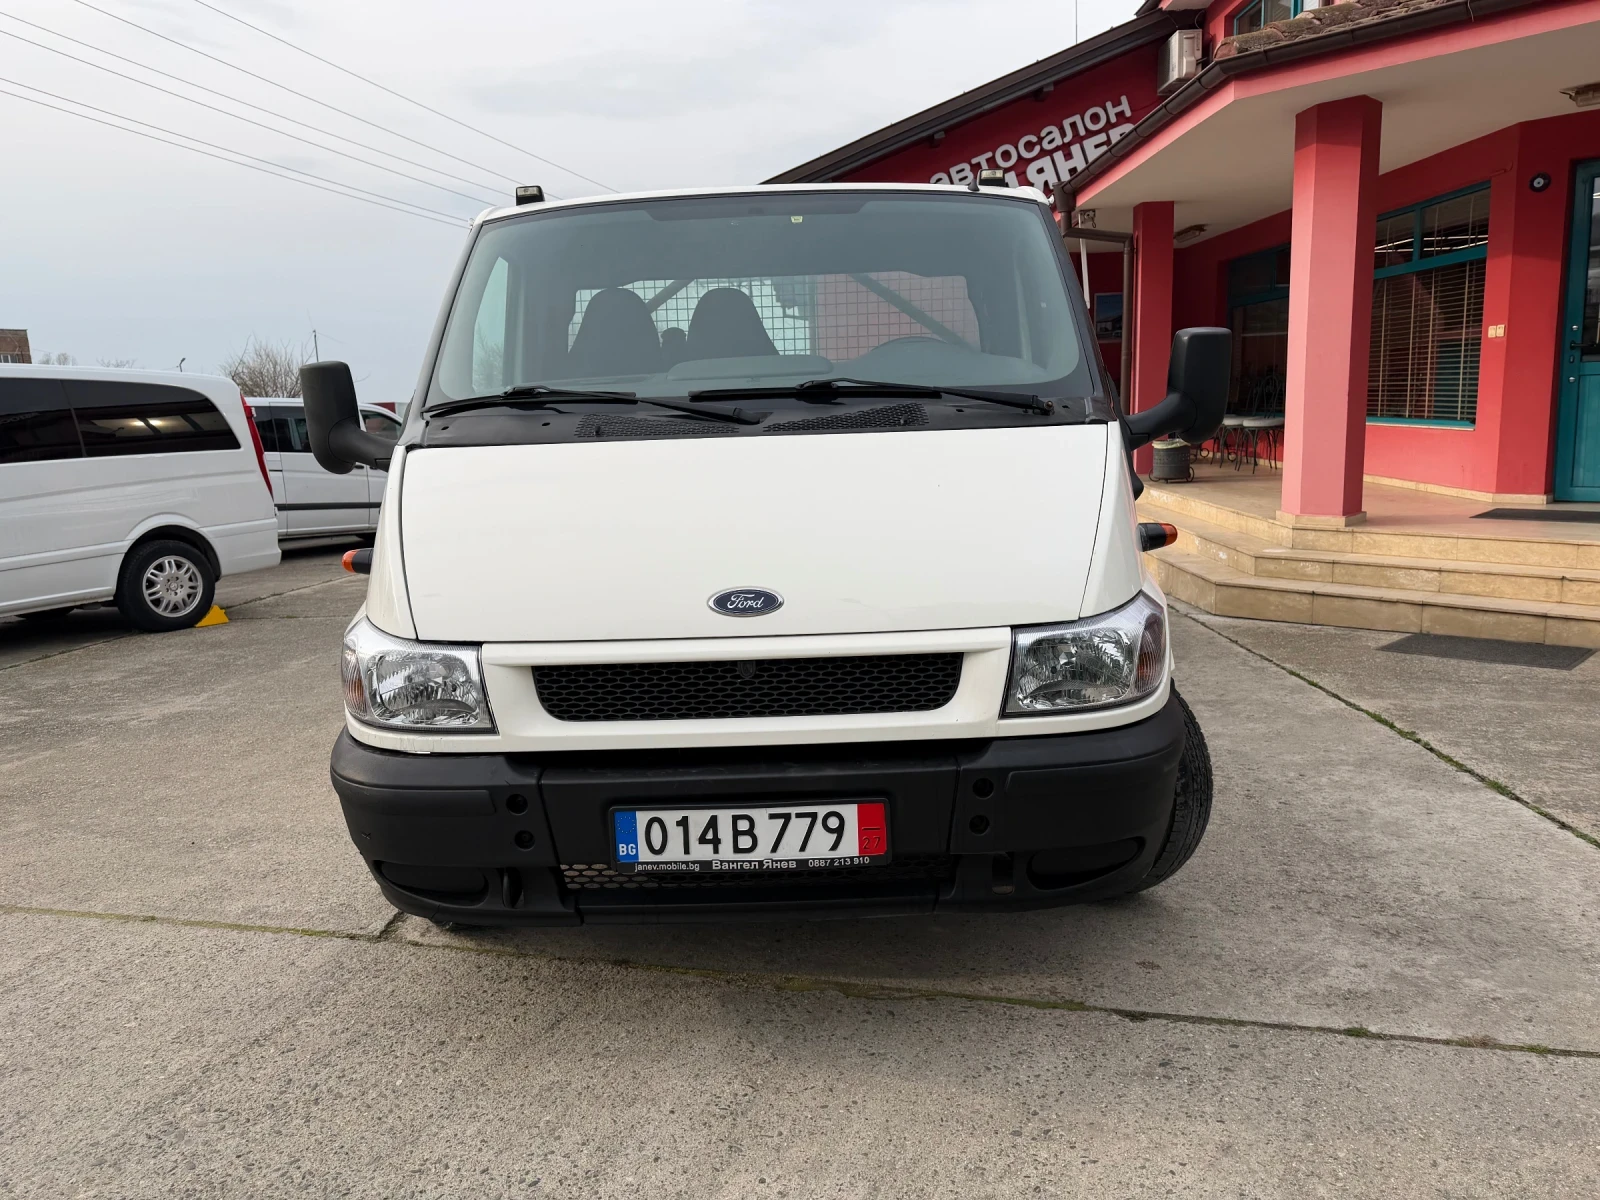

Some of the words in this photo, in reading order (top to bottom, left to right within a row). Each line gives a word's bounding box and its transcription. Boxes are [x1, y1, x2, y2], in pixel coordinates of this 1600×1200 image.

[727, 594, 764, 608] Ford
[862, 836, 881, 849] 27
[619, 844, 636, 855] BG
[634, 863, 700, 872] janev.mobile.bg
[712, 860, 759, 870] Вангел
[763, 859, 797, 869] Янев
[808, 859, 831, 868] 0887
[834, 857, 851, 866] 213
[854, 856, 870, 865] 910
